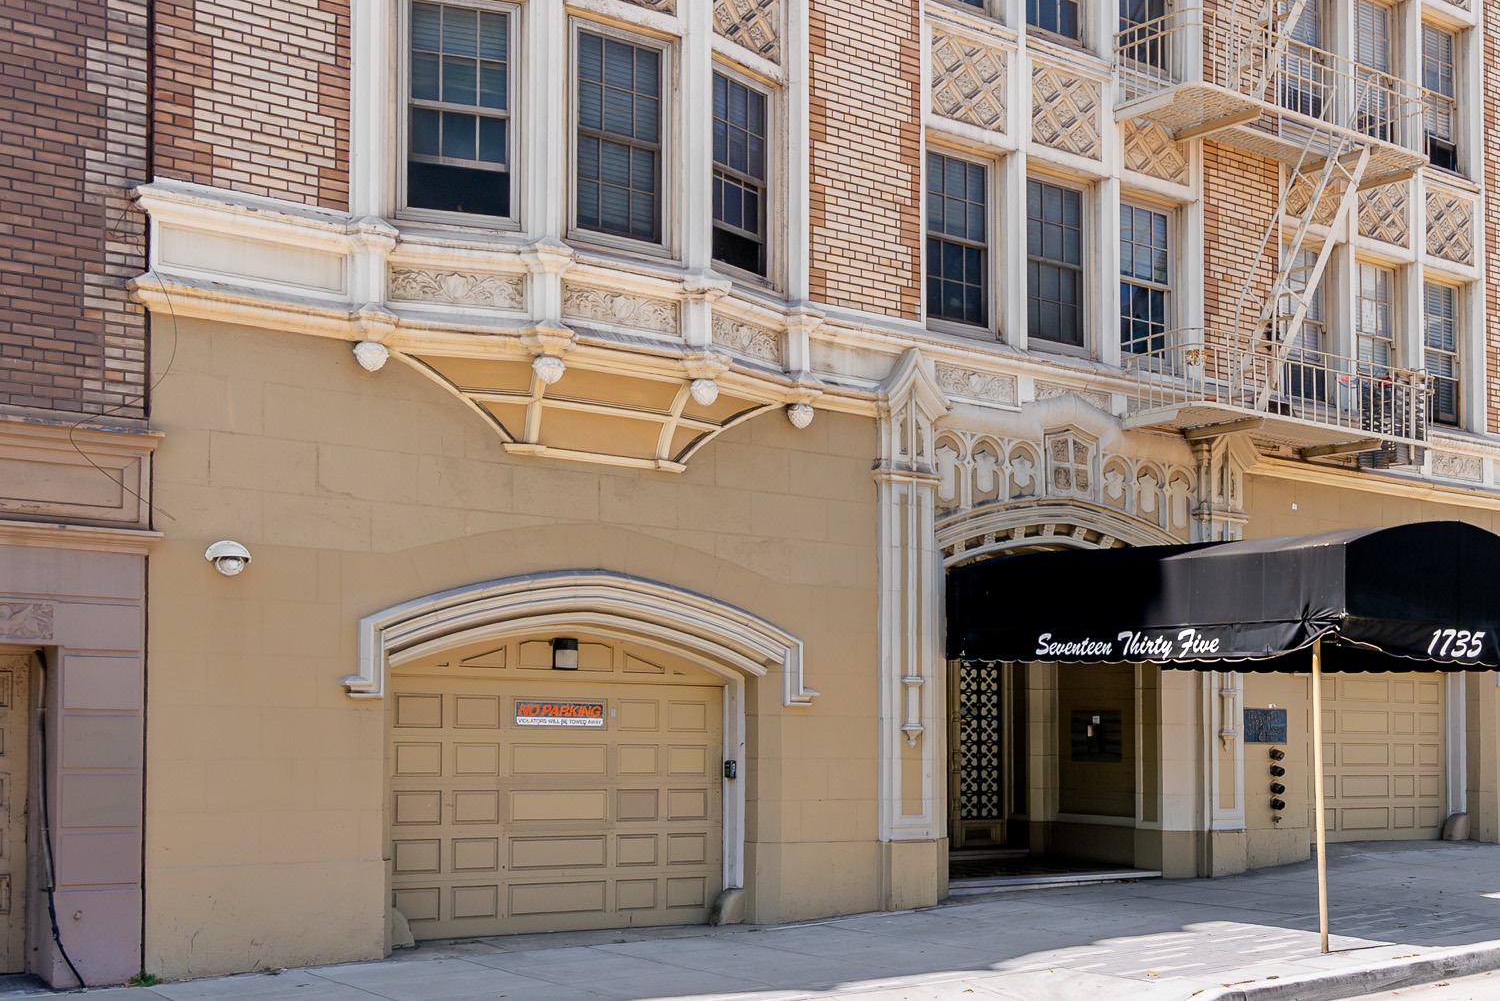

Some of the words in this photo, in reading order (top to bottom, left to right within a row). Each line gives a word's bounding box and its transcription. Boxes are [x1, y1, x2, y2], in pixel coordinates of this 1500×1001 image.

[1035, 632, 1113, 656] Seventeen
[1117, 630, 1173, 660] Thirty
[1177, 628, 1220, 658] Five
[1427, 628, 1486, 658] 1735
[518, 703, 540, 716] NO
[541, 704, 601, 717] PARKING
